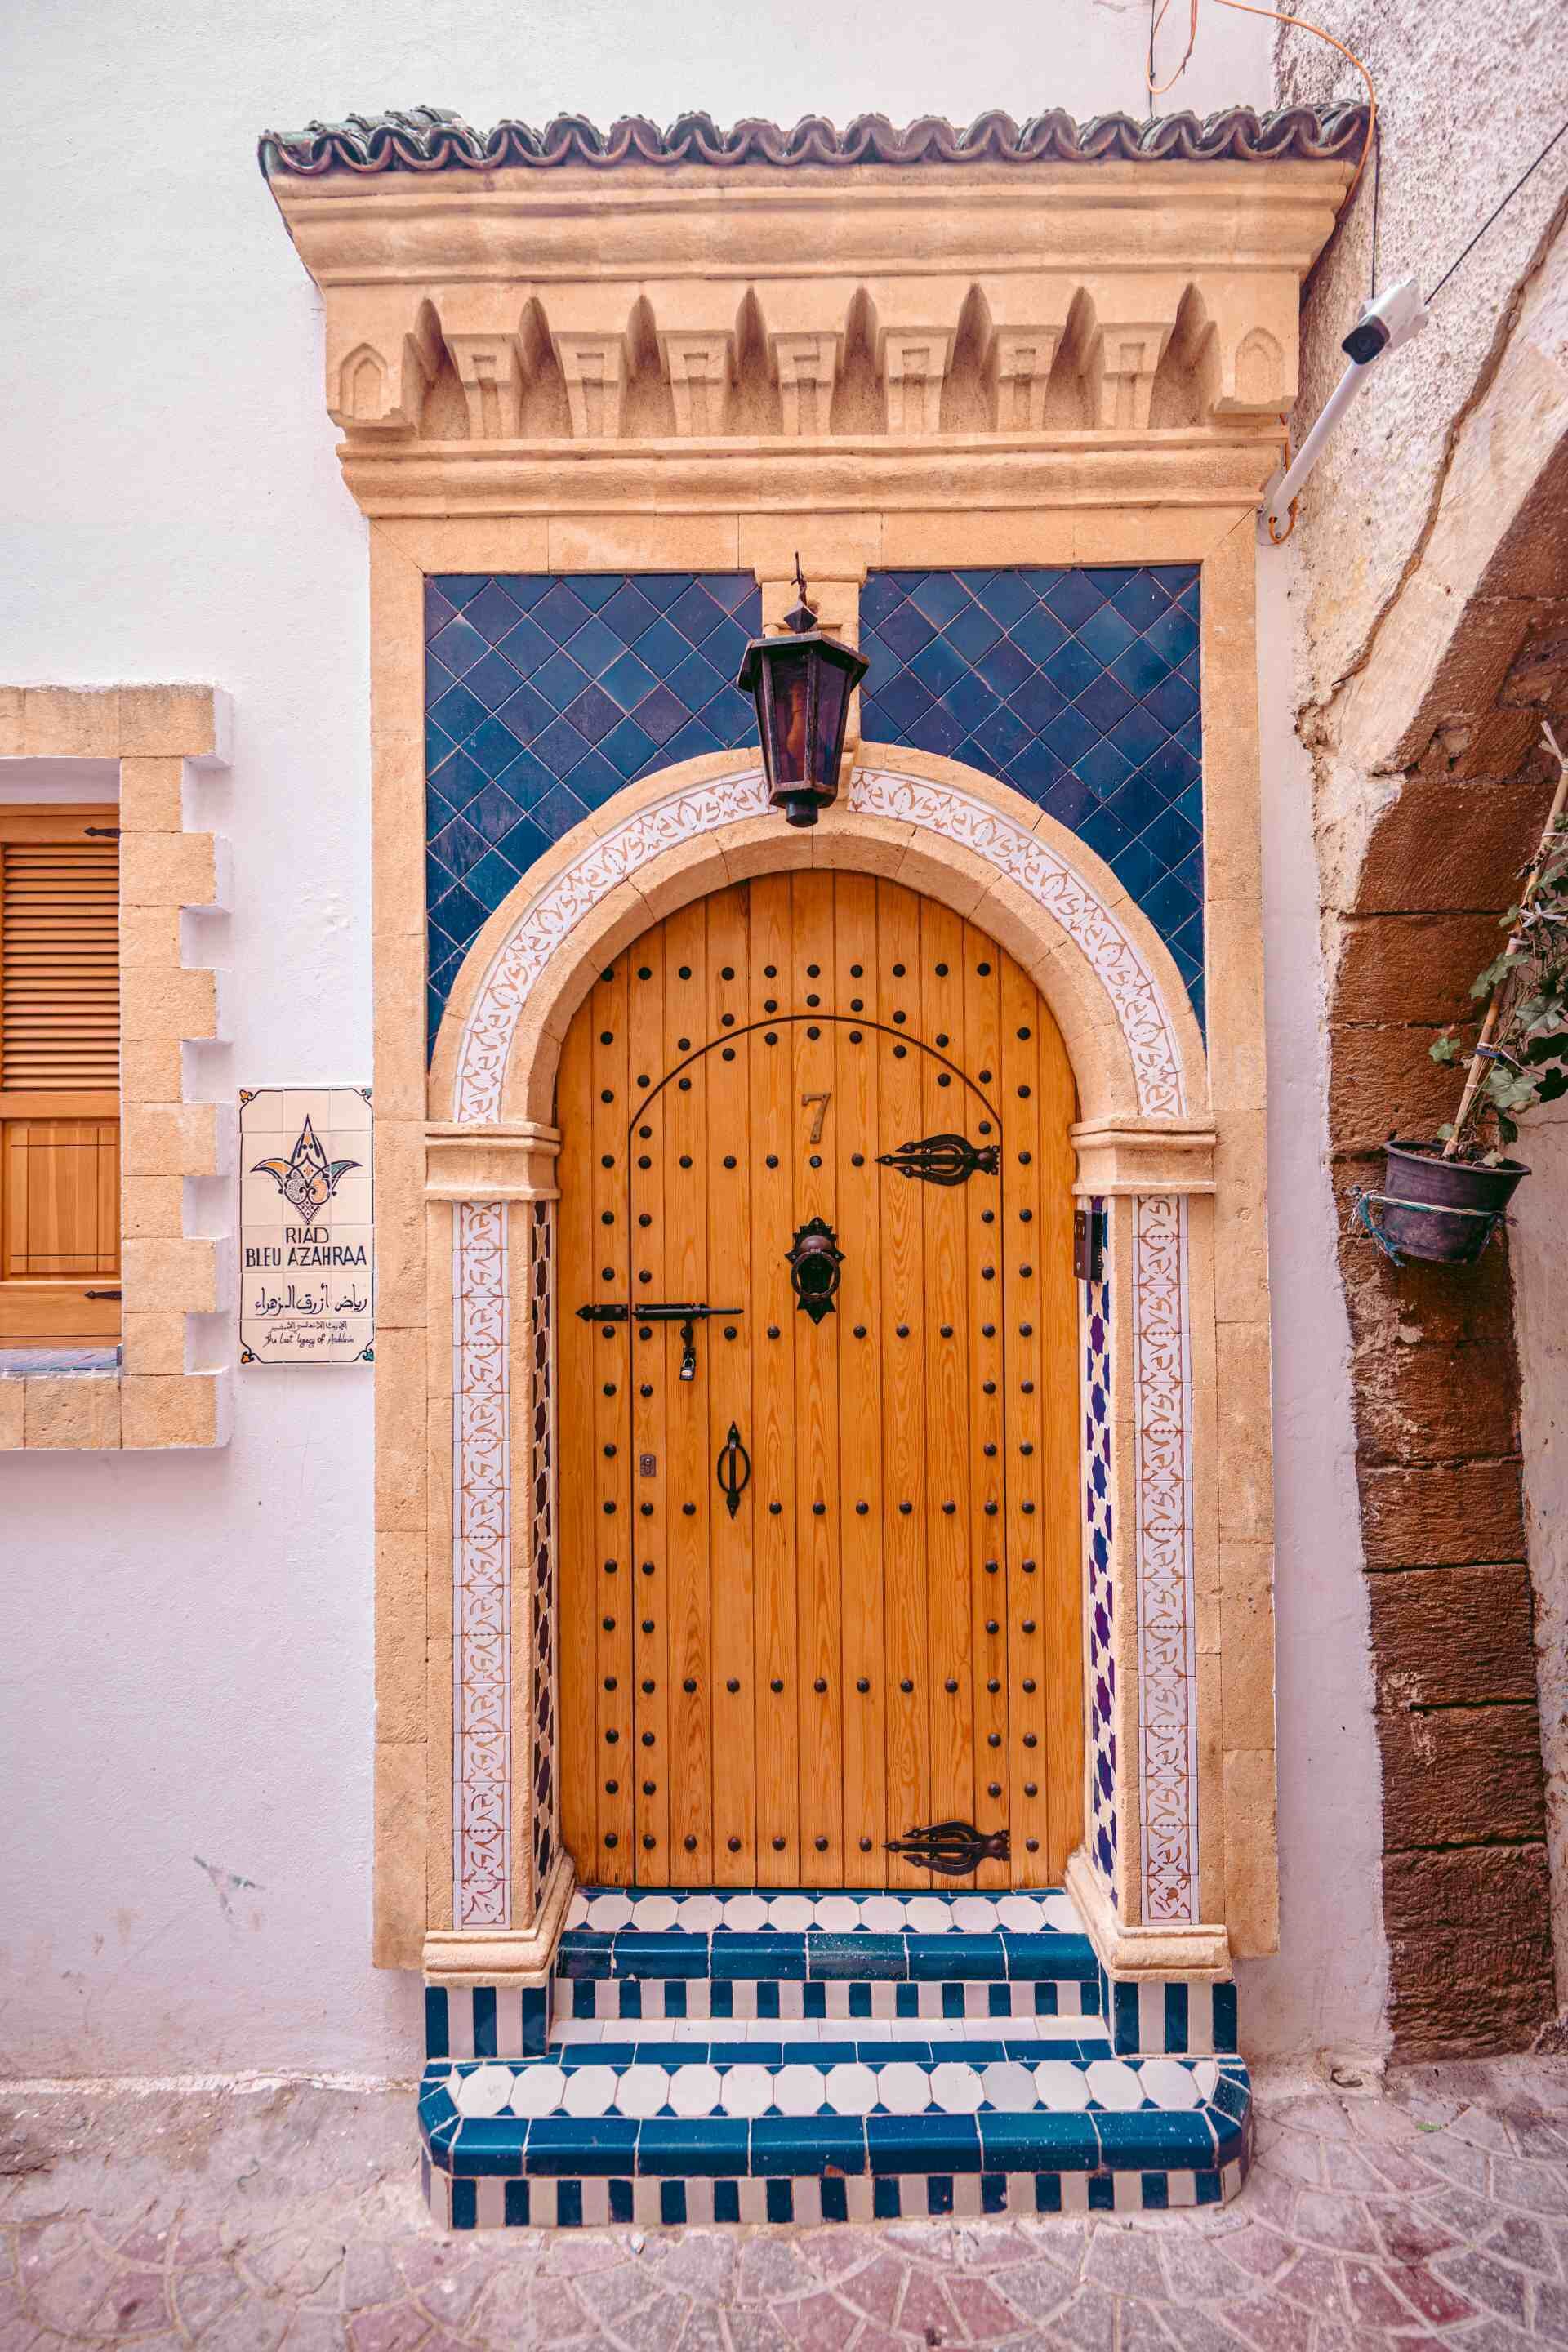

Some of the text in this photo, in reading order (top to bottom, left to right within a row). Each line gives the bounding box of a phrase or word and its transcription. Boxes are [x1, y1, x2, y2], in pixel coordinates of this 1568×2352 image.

[802, 1093, 831, 1144] 7
[286, 1227, 329, 1244] RIAD
[246, 1245, 367, 1267] BLEU AZAHRAA
[296, 1282, 330, 1314] أزرق
[334, 1283, 368, 1312] رياض
[317, 1333, 326, 1343] of
